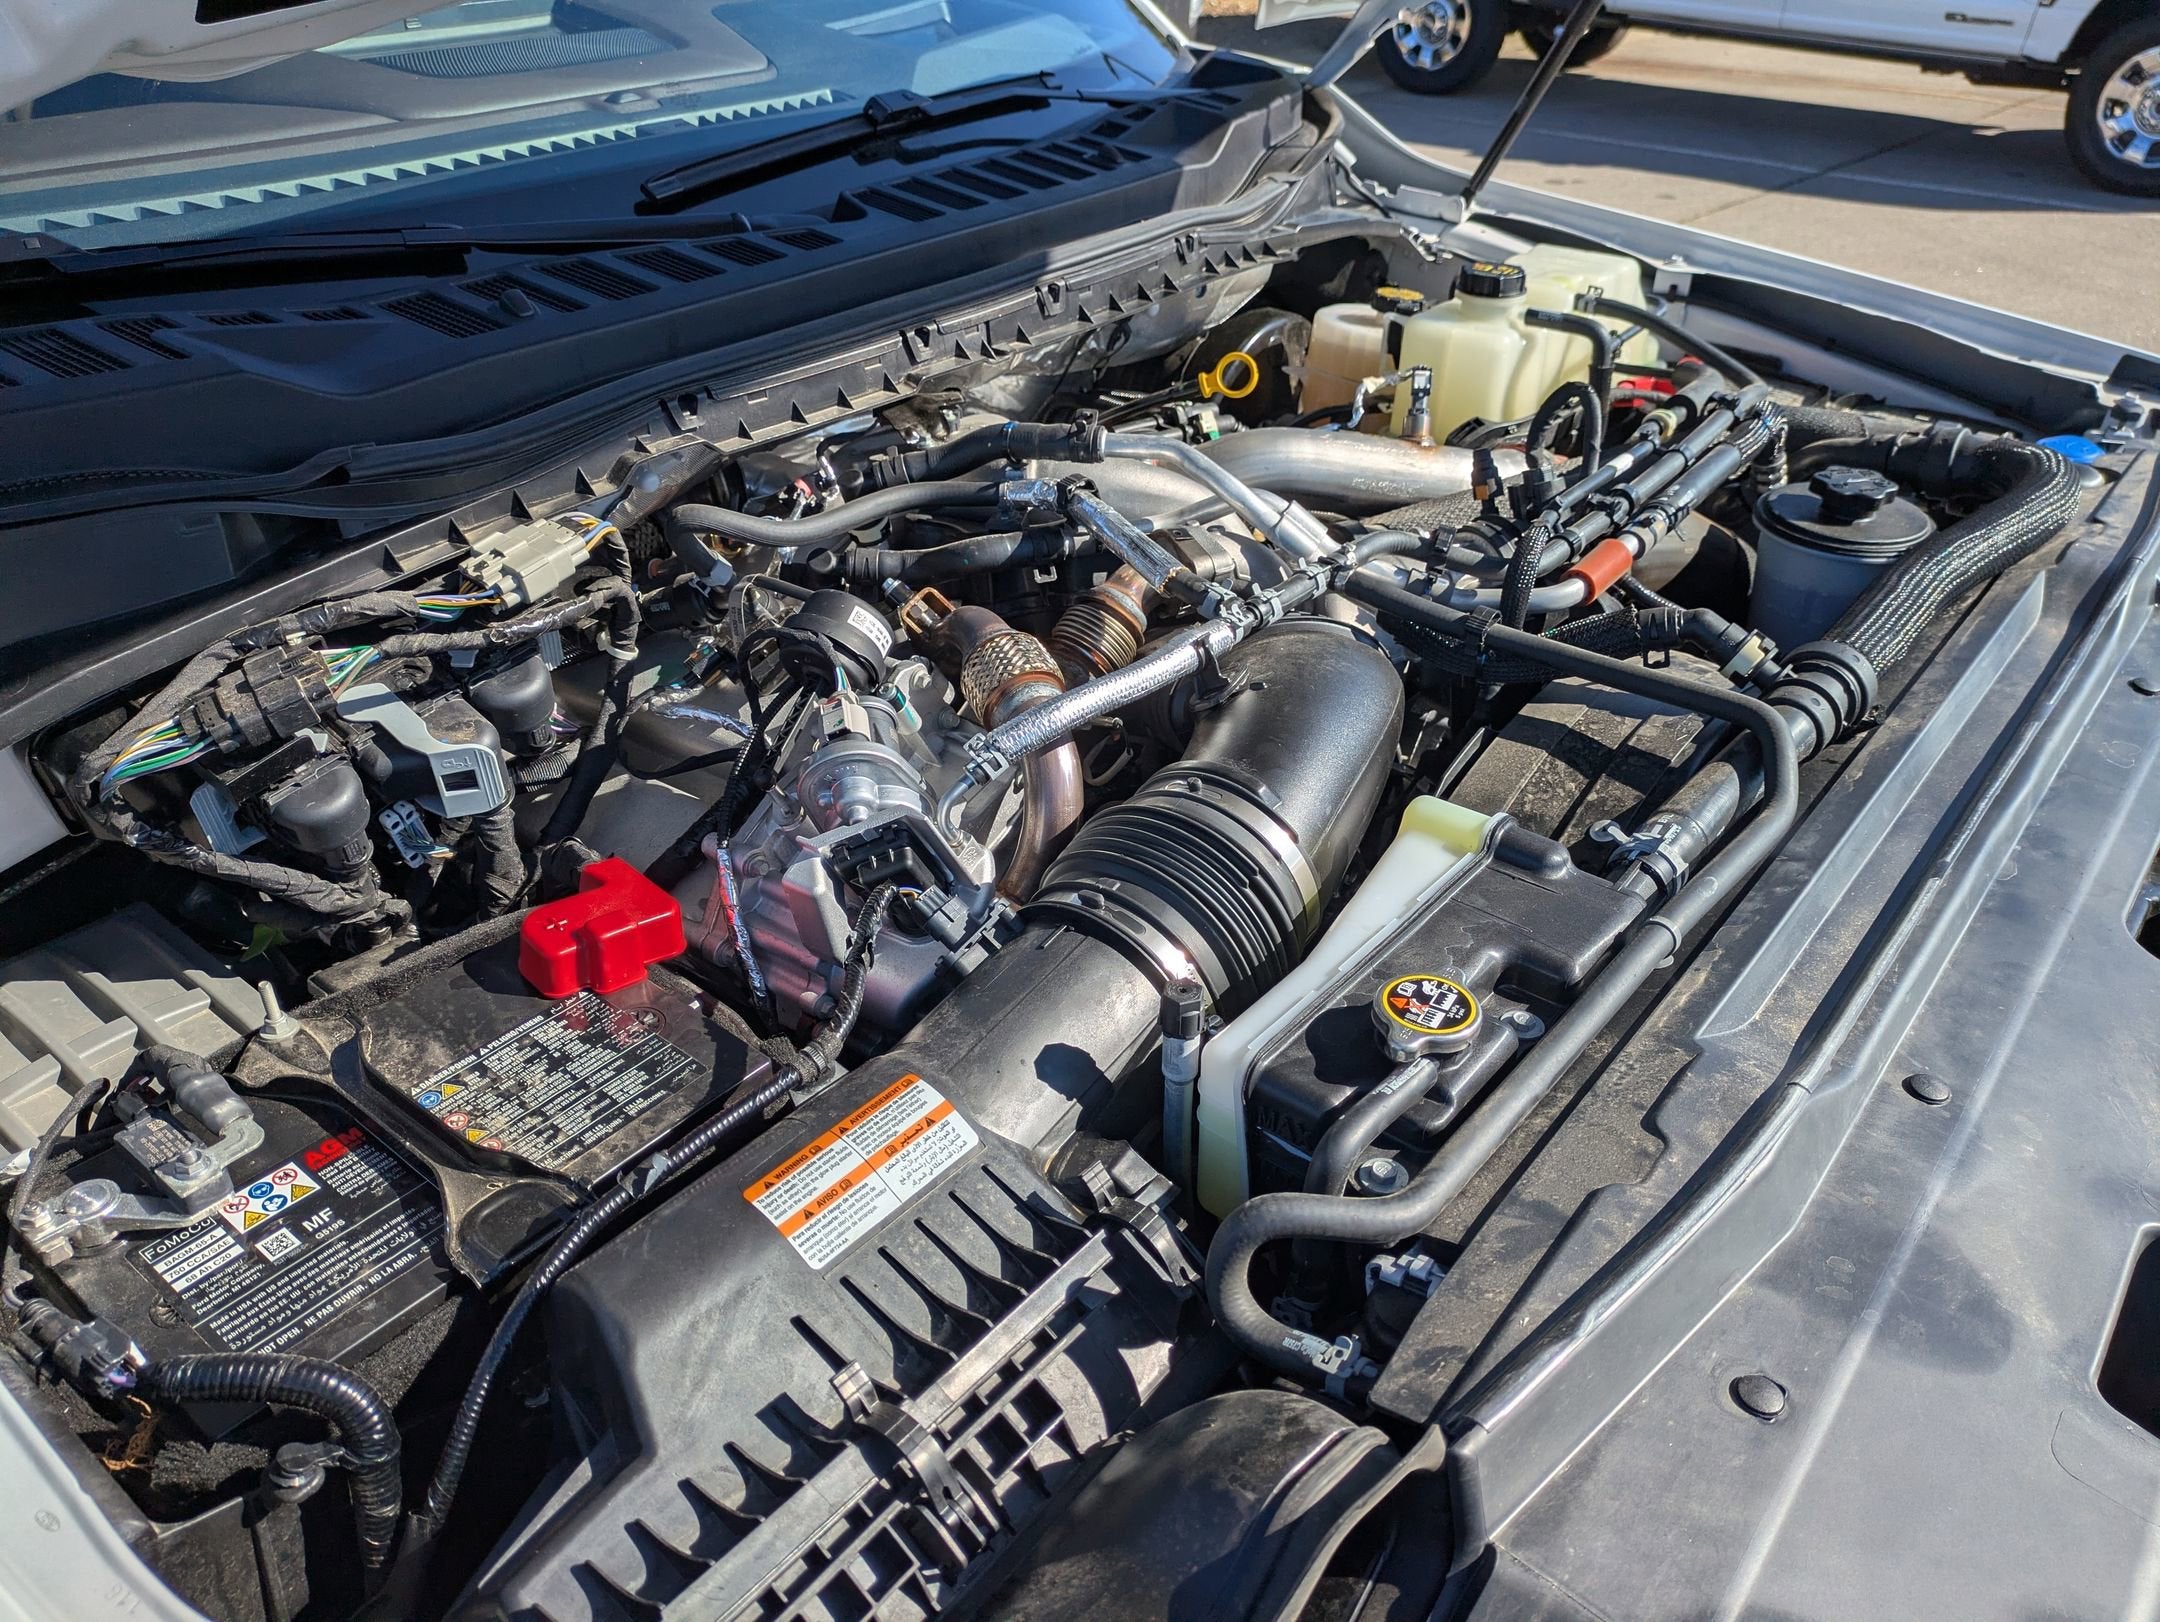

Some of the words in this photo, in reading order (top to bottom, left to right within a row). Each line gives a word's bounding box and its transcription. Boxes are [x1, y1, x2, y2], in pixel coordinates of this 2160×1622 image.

[486, 1015, 544, 1049] PELIGRO/VENENO
[418, 1054, 477, 1089] DANGER/POISON
[849, 1085, 901, 1125] AVERTISSEMENT
[299, 1126, 364, 1165] AGM
[821, 1154, 836, 1165] starter
[763, 1185, 781, 1199] reduce
[796, 1160, 817, 1176] possible
[815, 1147, 834, 1161] serious
[773, 1153, 808, 1179] WARNING
[817, 1168, 829, 1178] glow
[828, 1160, 840, 1170] plug
[838, 1150, 852, 1162] starter
[791, 1230, 805, 1241] Para
[803, 1217, 822, 1232] reducir
[826, 1201, 843, 1215] riesgo
[847, 1182, 868, 1198] lesiones
[815, 1188, 838, 1208] AVISO
[301, 1207, 334, 1231] MF
[314, 1218, 345, 1239] G519S
[143, 1216, 211, 1259] FoMoCo
[163, 1233, 217, 1266] BAGM-65-A
[167, 1266, 186, 1278] 750
[185, 1239, 230, 1267] CCA/SAE
[198, 1265, 212, 1275] Ah
[212, 1252, 232, 1265] C20
[302, 1280, 315, 1290] con
[314, 1259, 348, 1282] materiales
[181, 1287, 199, 1299] Dist.
[191, 1296, 209, 1309] Ford
[208, 1283, 229, 1298] Motor
[229, 1263, 265, 1285] Company,
[196, 1291, 232, 1315] Dearborn,
[209, 1314, 229, 1328] Made
[236, 1300, 252, 1311] USA
[251, 1290, 267, 1302] with
[276, 1276, 289, 1286] and
[288, 1257, 318, 1278] imported
[215, 1314, 246, 1335] Fabriqué
[246, 1306, 259, 1316] aux
[291, 1275, 307, 1287] avec
[306, 1267, 319, 1277] des
[318, 1247, 350, 1269] matériaux
[275, 1326, 303, 1345] OPEN.
[303, 1315, 317, 1326] NE
[315, 1304, 334, 1318] PAS
[332, 1283, 367, 1307] OUVRIR.
[367, 1273, 382, 1284] NO
[379, 1266, 393, 1276] LA
[391, 1251, 417, 1269] ABRA.
